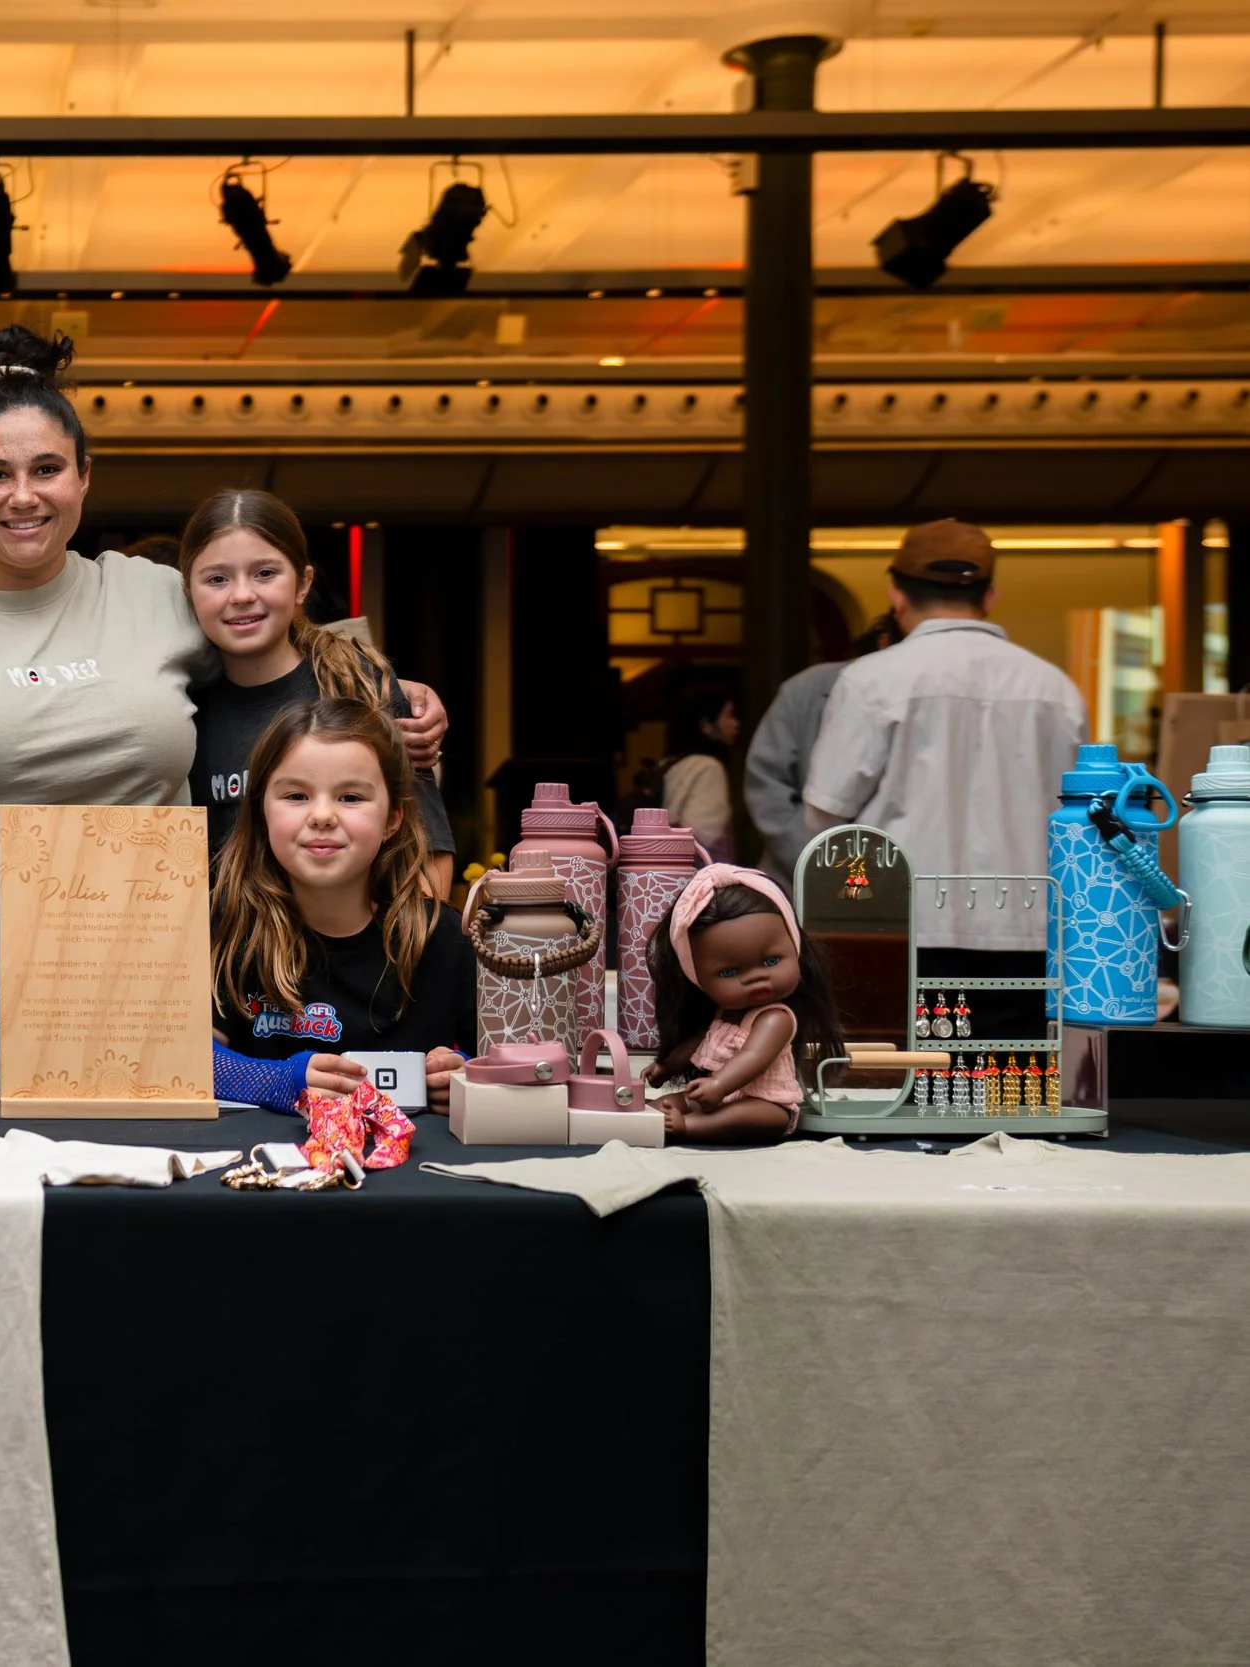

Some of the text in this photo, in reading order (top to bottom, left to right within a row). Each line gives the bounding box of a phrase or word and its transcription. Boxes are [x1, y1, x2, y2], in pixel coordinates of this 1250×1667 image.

[6, 658, 102, 688] MOB DEEP
[37, 874, 175, 902] Dollies Tribe
[96, 910, 151, 921] acknowlege
[26, 923, 70, 931] traitional
[72, 923, 120, 932] custodians
[136, 960, 152, 968] and
[308, 1006, 333, 1016] AFL
[73, 1023, 105, 1032] respe
[142, 1023, 188, 1033] Aoriginal
[255, 1013, 338, 1038] Auskick
